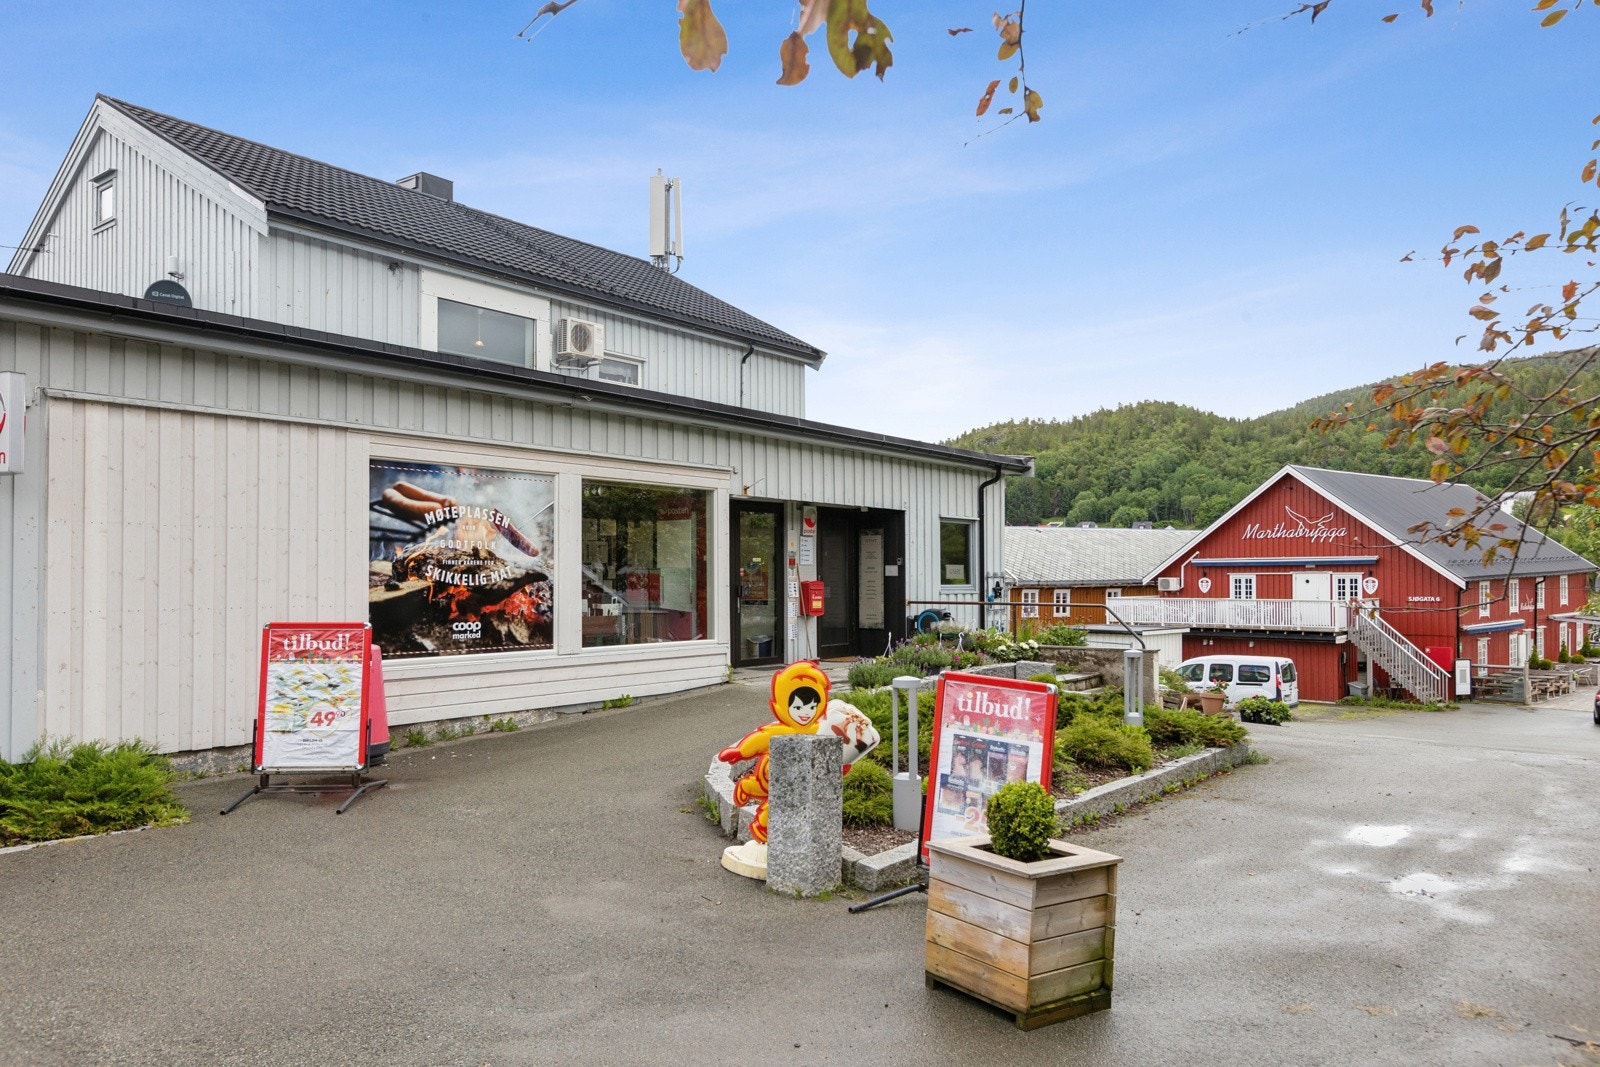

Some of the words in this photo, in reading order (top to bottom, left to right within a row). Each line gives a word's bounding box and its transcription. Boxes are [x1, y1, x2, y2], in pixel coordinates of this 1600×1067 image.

[424, 506, 511, 529] MØTEPLASSEN
[1241, 522, 1347, 543] Marthabrygga
[440, 539, 497, 550] GODTFOLK
[425, 565, 487, 586] SKIKKELIG
[490, 566, 512, 583] MAT
[452, 621, 482, 632] coop
[452, 631, 482, 640] marked
[282, 633, 351, 651] tilbud!
[957, 691, 1031, 721] tilbud!
